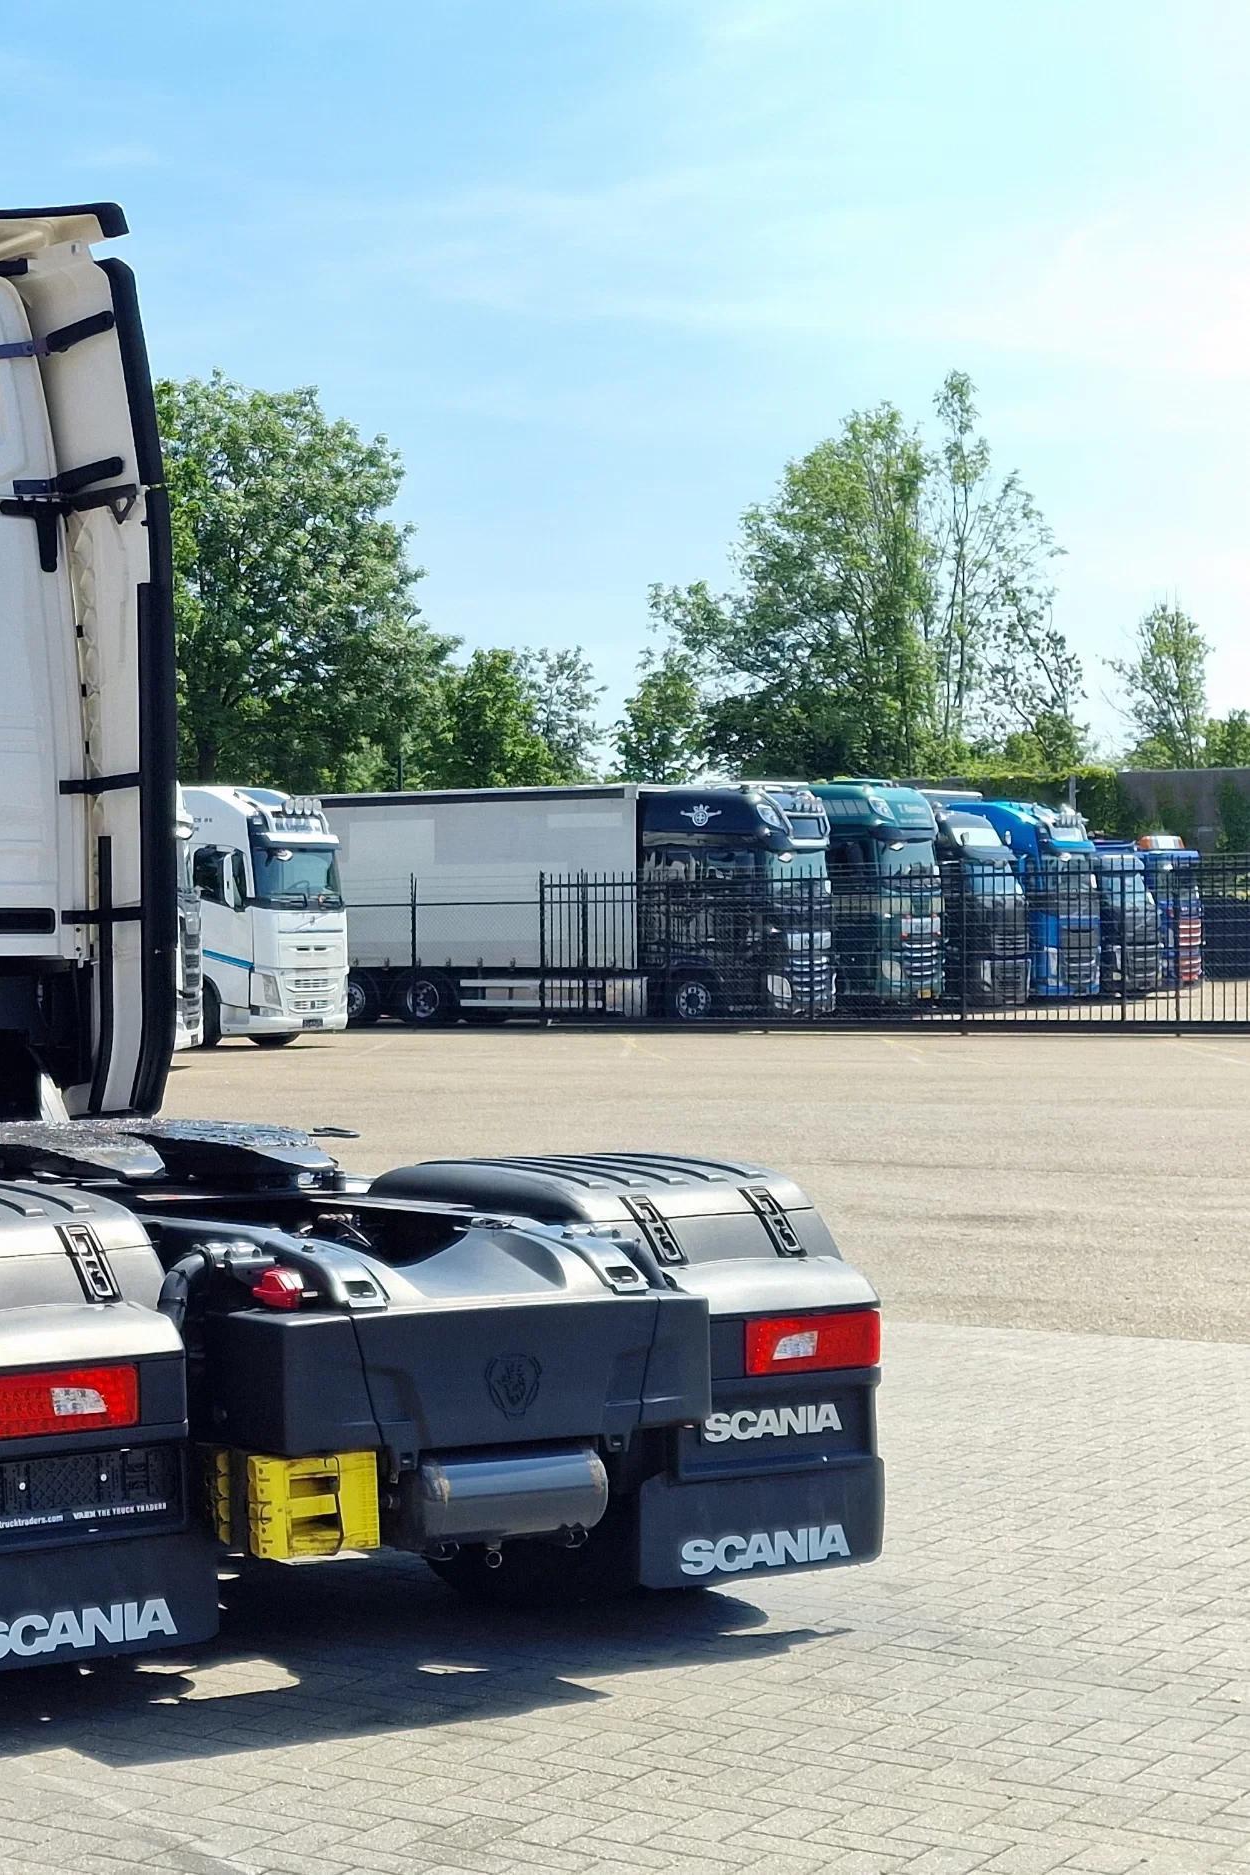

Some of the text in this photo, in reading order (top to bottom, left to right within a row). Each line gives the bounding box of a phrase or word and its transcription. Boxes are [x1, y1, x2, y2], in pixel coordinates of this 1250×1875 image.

[704, 1403, 842, 1443] SCANIA
[97, 1508, 111, 1517] THE
[112, 1505, 135, 1515] TRUCK
[136, 1502, 167, 1512] TRADERS
[680, 1523, 851, 1576] SCANIA
